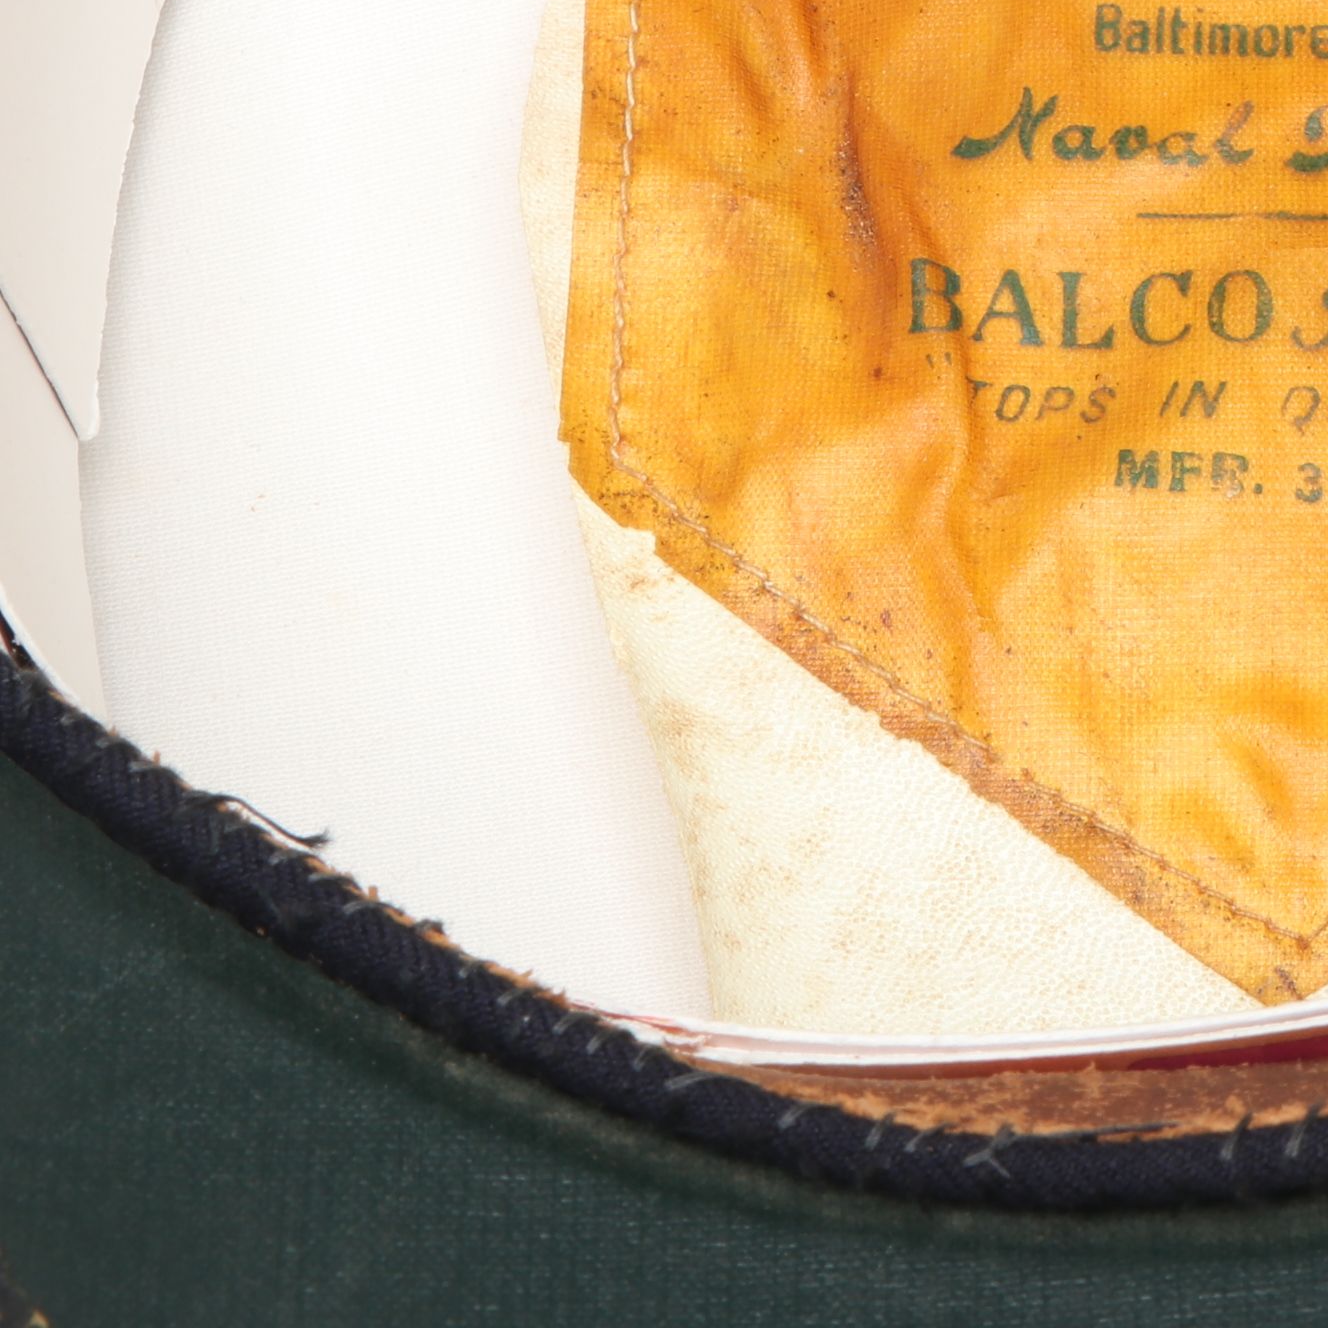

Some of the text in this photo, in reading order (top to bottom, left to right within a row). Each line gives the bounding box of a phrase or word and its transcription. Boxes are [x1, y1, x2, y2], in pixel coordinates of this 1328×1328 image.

[951, 86, 1256, 162] Naval
[908, 256, 1275, 352] BALCO
[1159, 379, 1227, 420] IN
